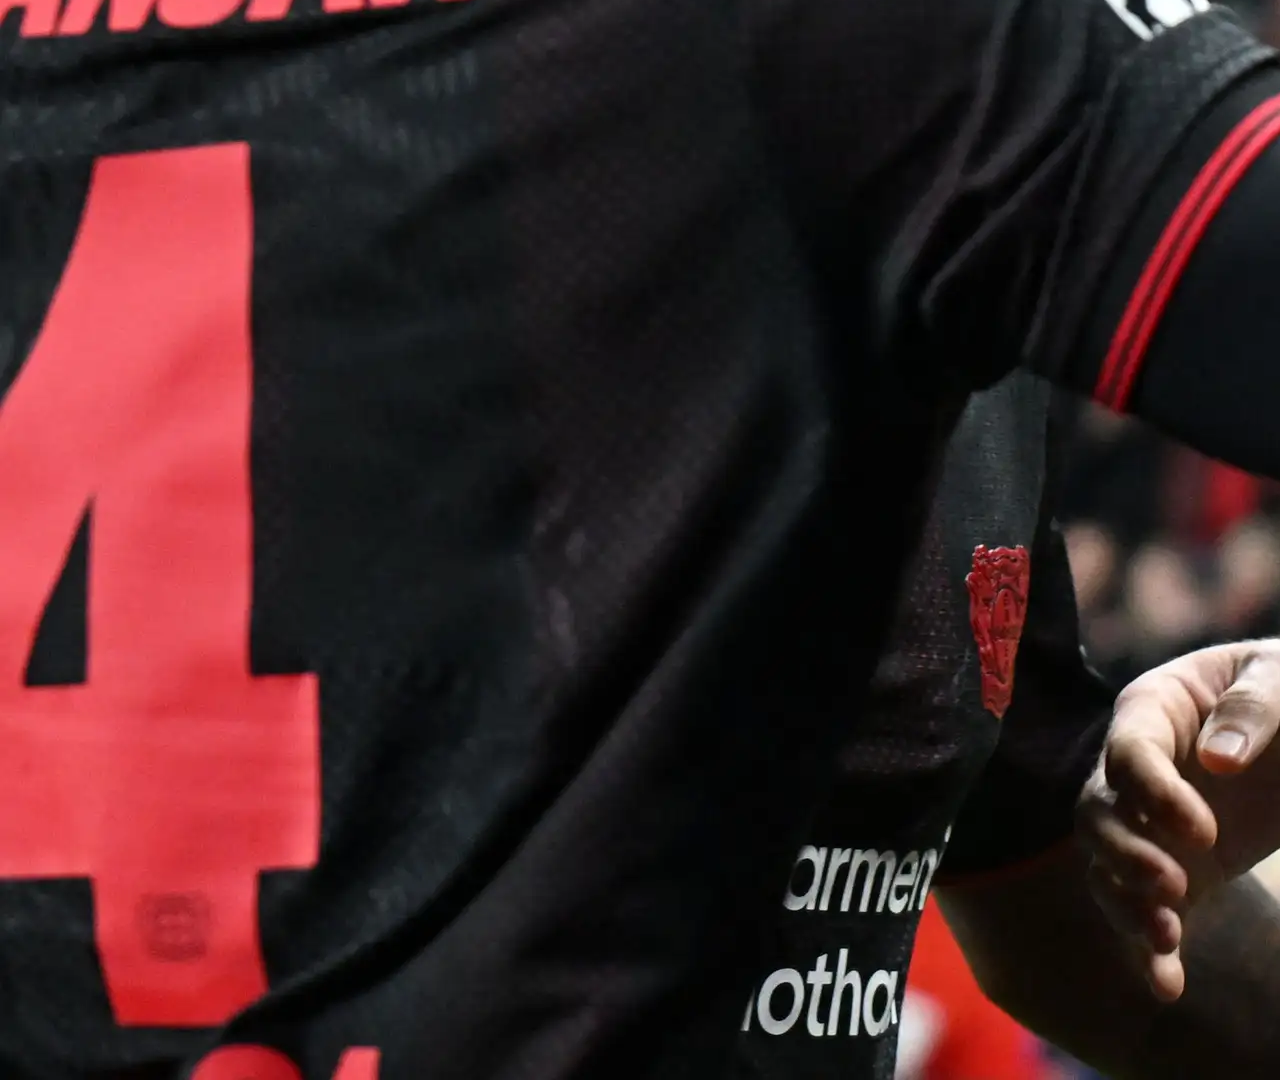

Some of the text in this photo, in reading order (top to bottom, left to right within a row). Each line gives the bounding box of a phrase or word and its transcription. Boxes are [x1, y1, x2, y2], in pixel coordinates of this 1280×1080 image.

[0, 141, 319, 1027] 4
[782, 842, 943, 914] armen
[740, 948, 898, 1037] otha
